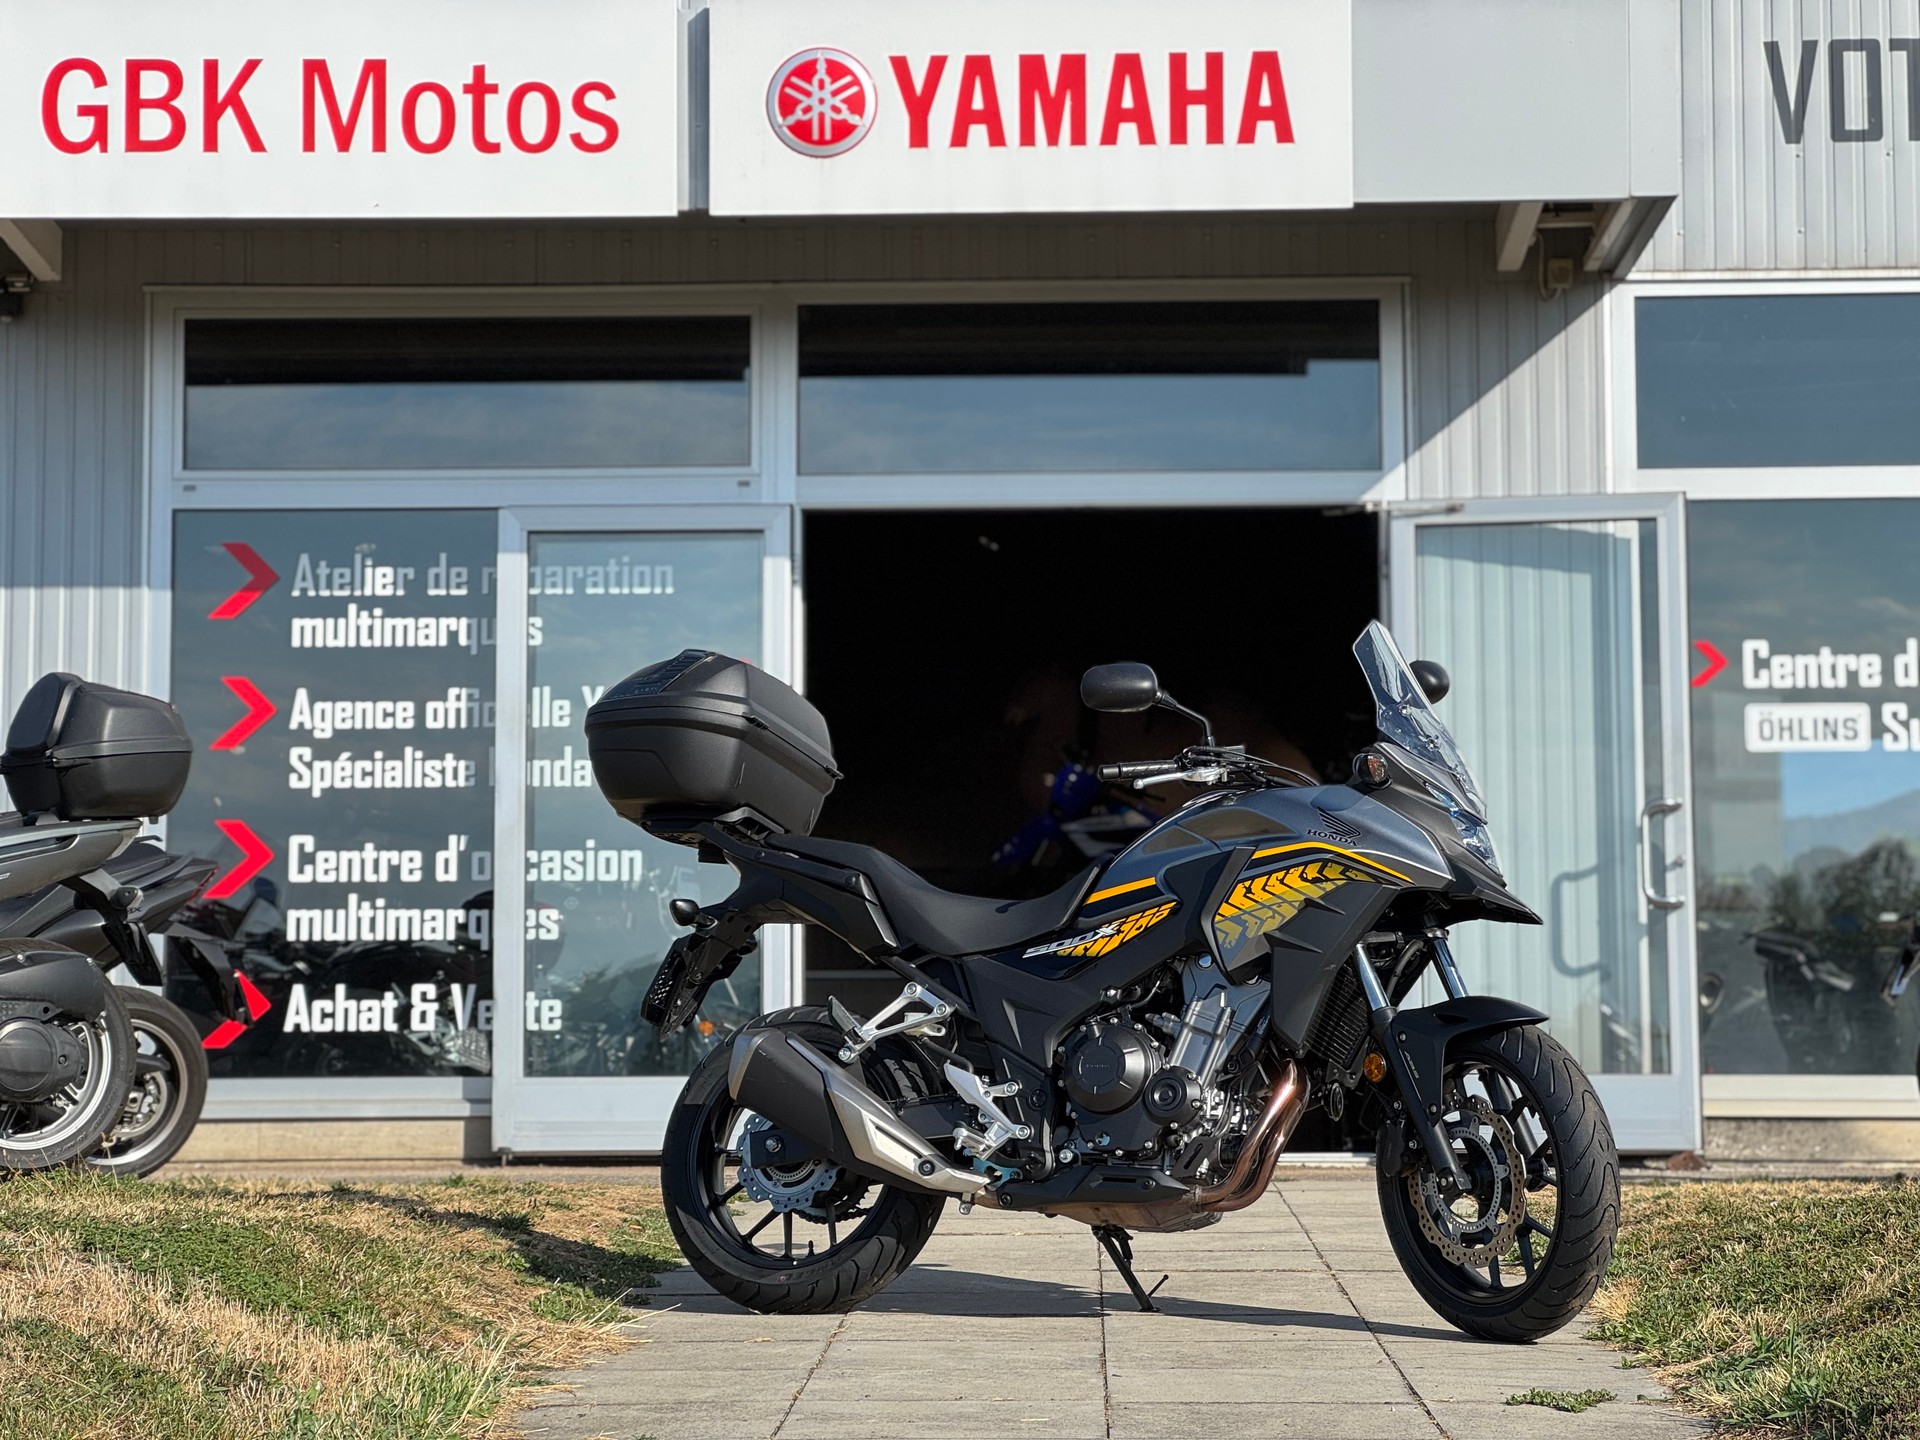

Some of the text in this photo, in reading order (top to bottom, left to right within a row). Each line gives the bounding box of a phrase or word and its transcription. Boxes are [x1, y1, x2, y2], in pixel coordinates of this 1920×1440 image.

[41, 57, 620, 155] GBK Motos
[888, 50, 1296, 149] YAMAHA
[1762, 37, 1920, 145] VOT
[291, 553, 415, 597] Atelier
[427, 552, 468, 596] de
[291, 602, 543, 655] multimarqus
[1742, 637, 1882, 689] Centre
[288, 687, 415, 739] Agence
[1758, 710, 1859, 742] ÖHLINS
[288, 746, 476, 798] Spécialiste
[287, 834, 423, 883] Centre
[1306, 829, 1358, 847] HONDA
[286, 893, 560, 951] multimarqes
[1022, 917, 1127, 959] 500X
[282, 982, 562, 1033] Achat & Vete
